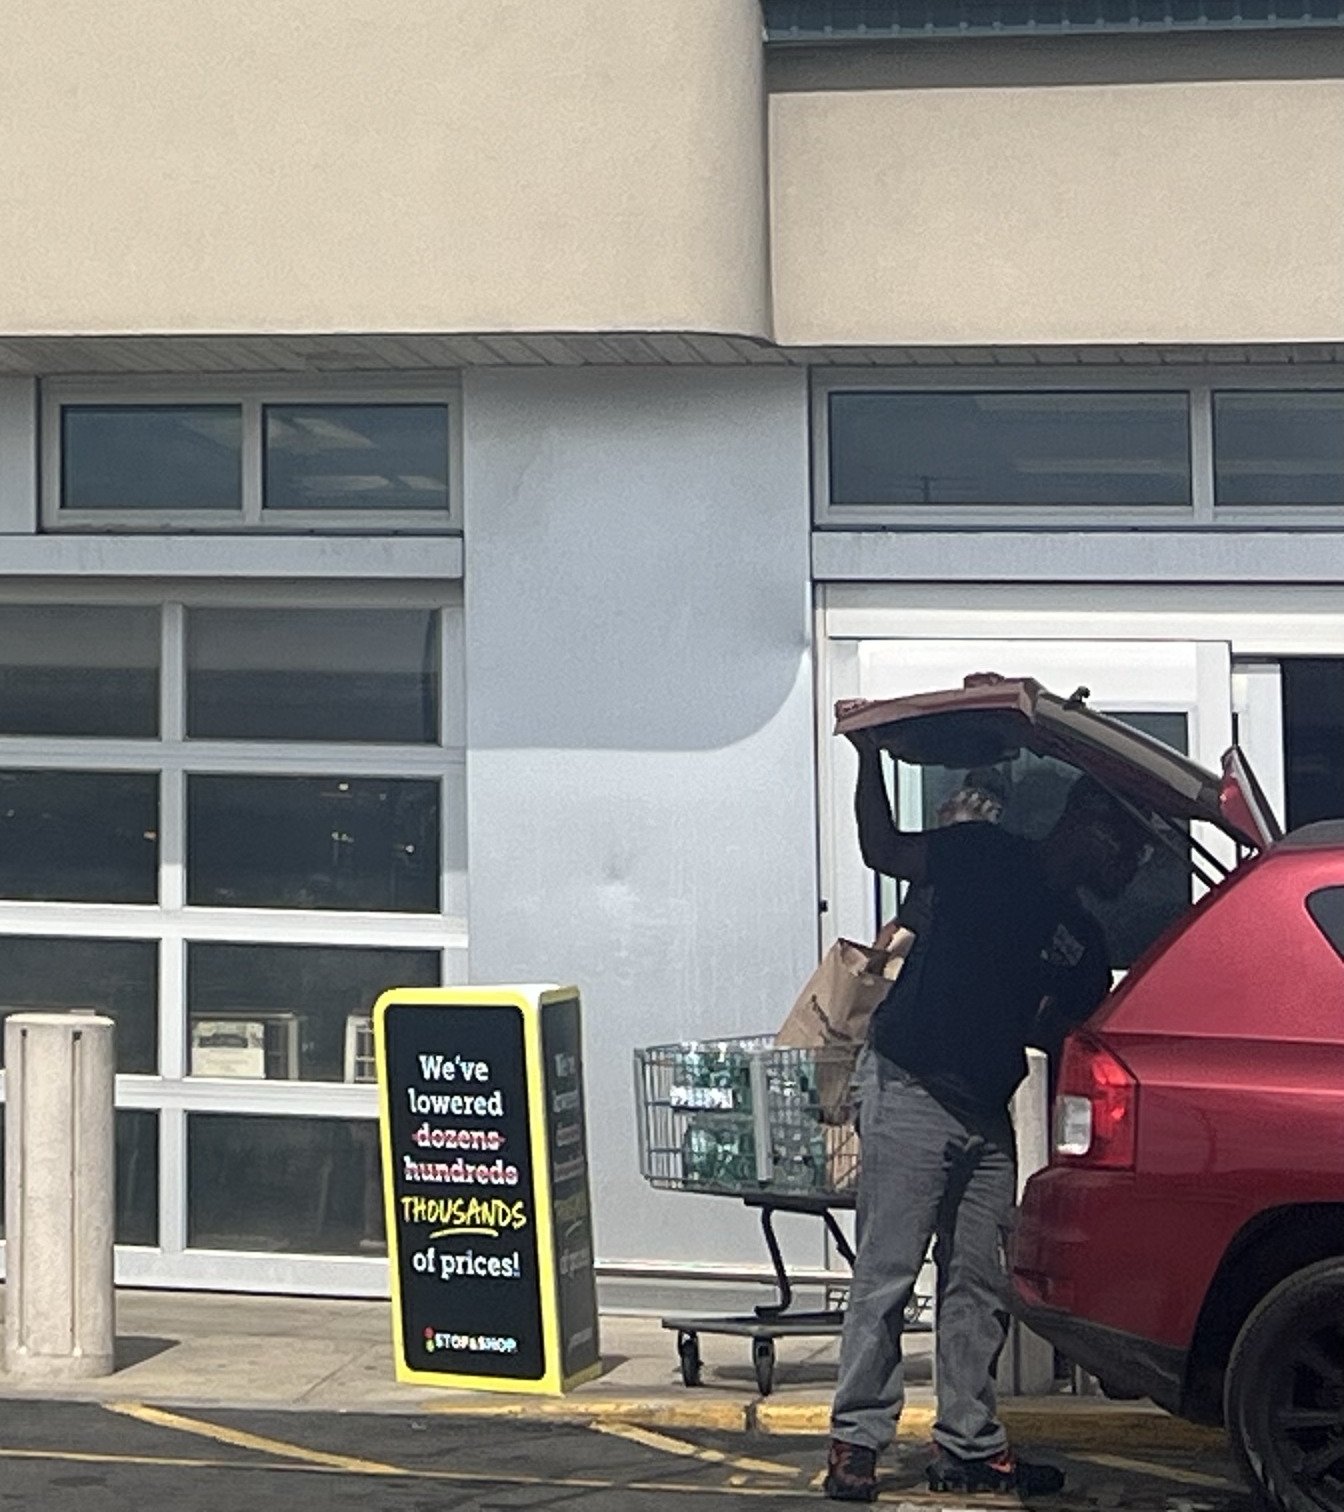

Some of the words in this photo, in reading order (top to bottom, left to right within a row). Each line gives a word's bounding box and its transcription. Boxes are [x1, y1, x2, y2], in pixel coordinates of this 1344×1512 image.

[418, 1053, 490, 1082] We've
[407, 1087, 505, 1117] lowered
[414, 1121, 502, 1151] dozens
[403, 1154, 519, 1186] hundreds
[400, 1196, 528, 1230] THOUSANDS
[412, 1246, 436, 1273] of
[439, 1249, 521, 1281] prices!
